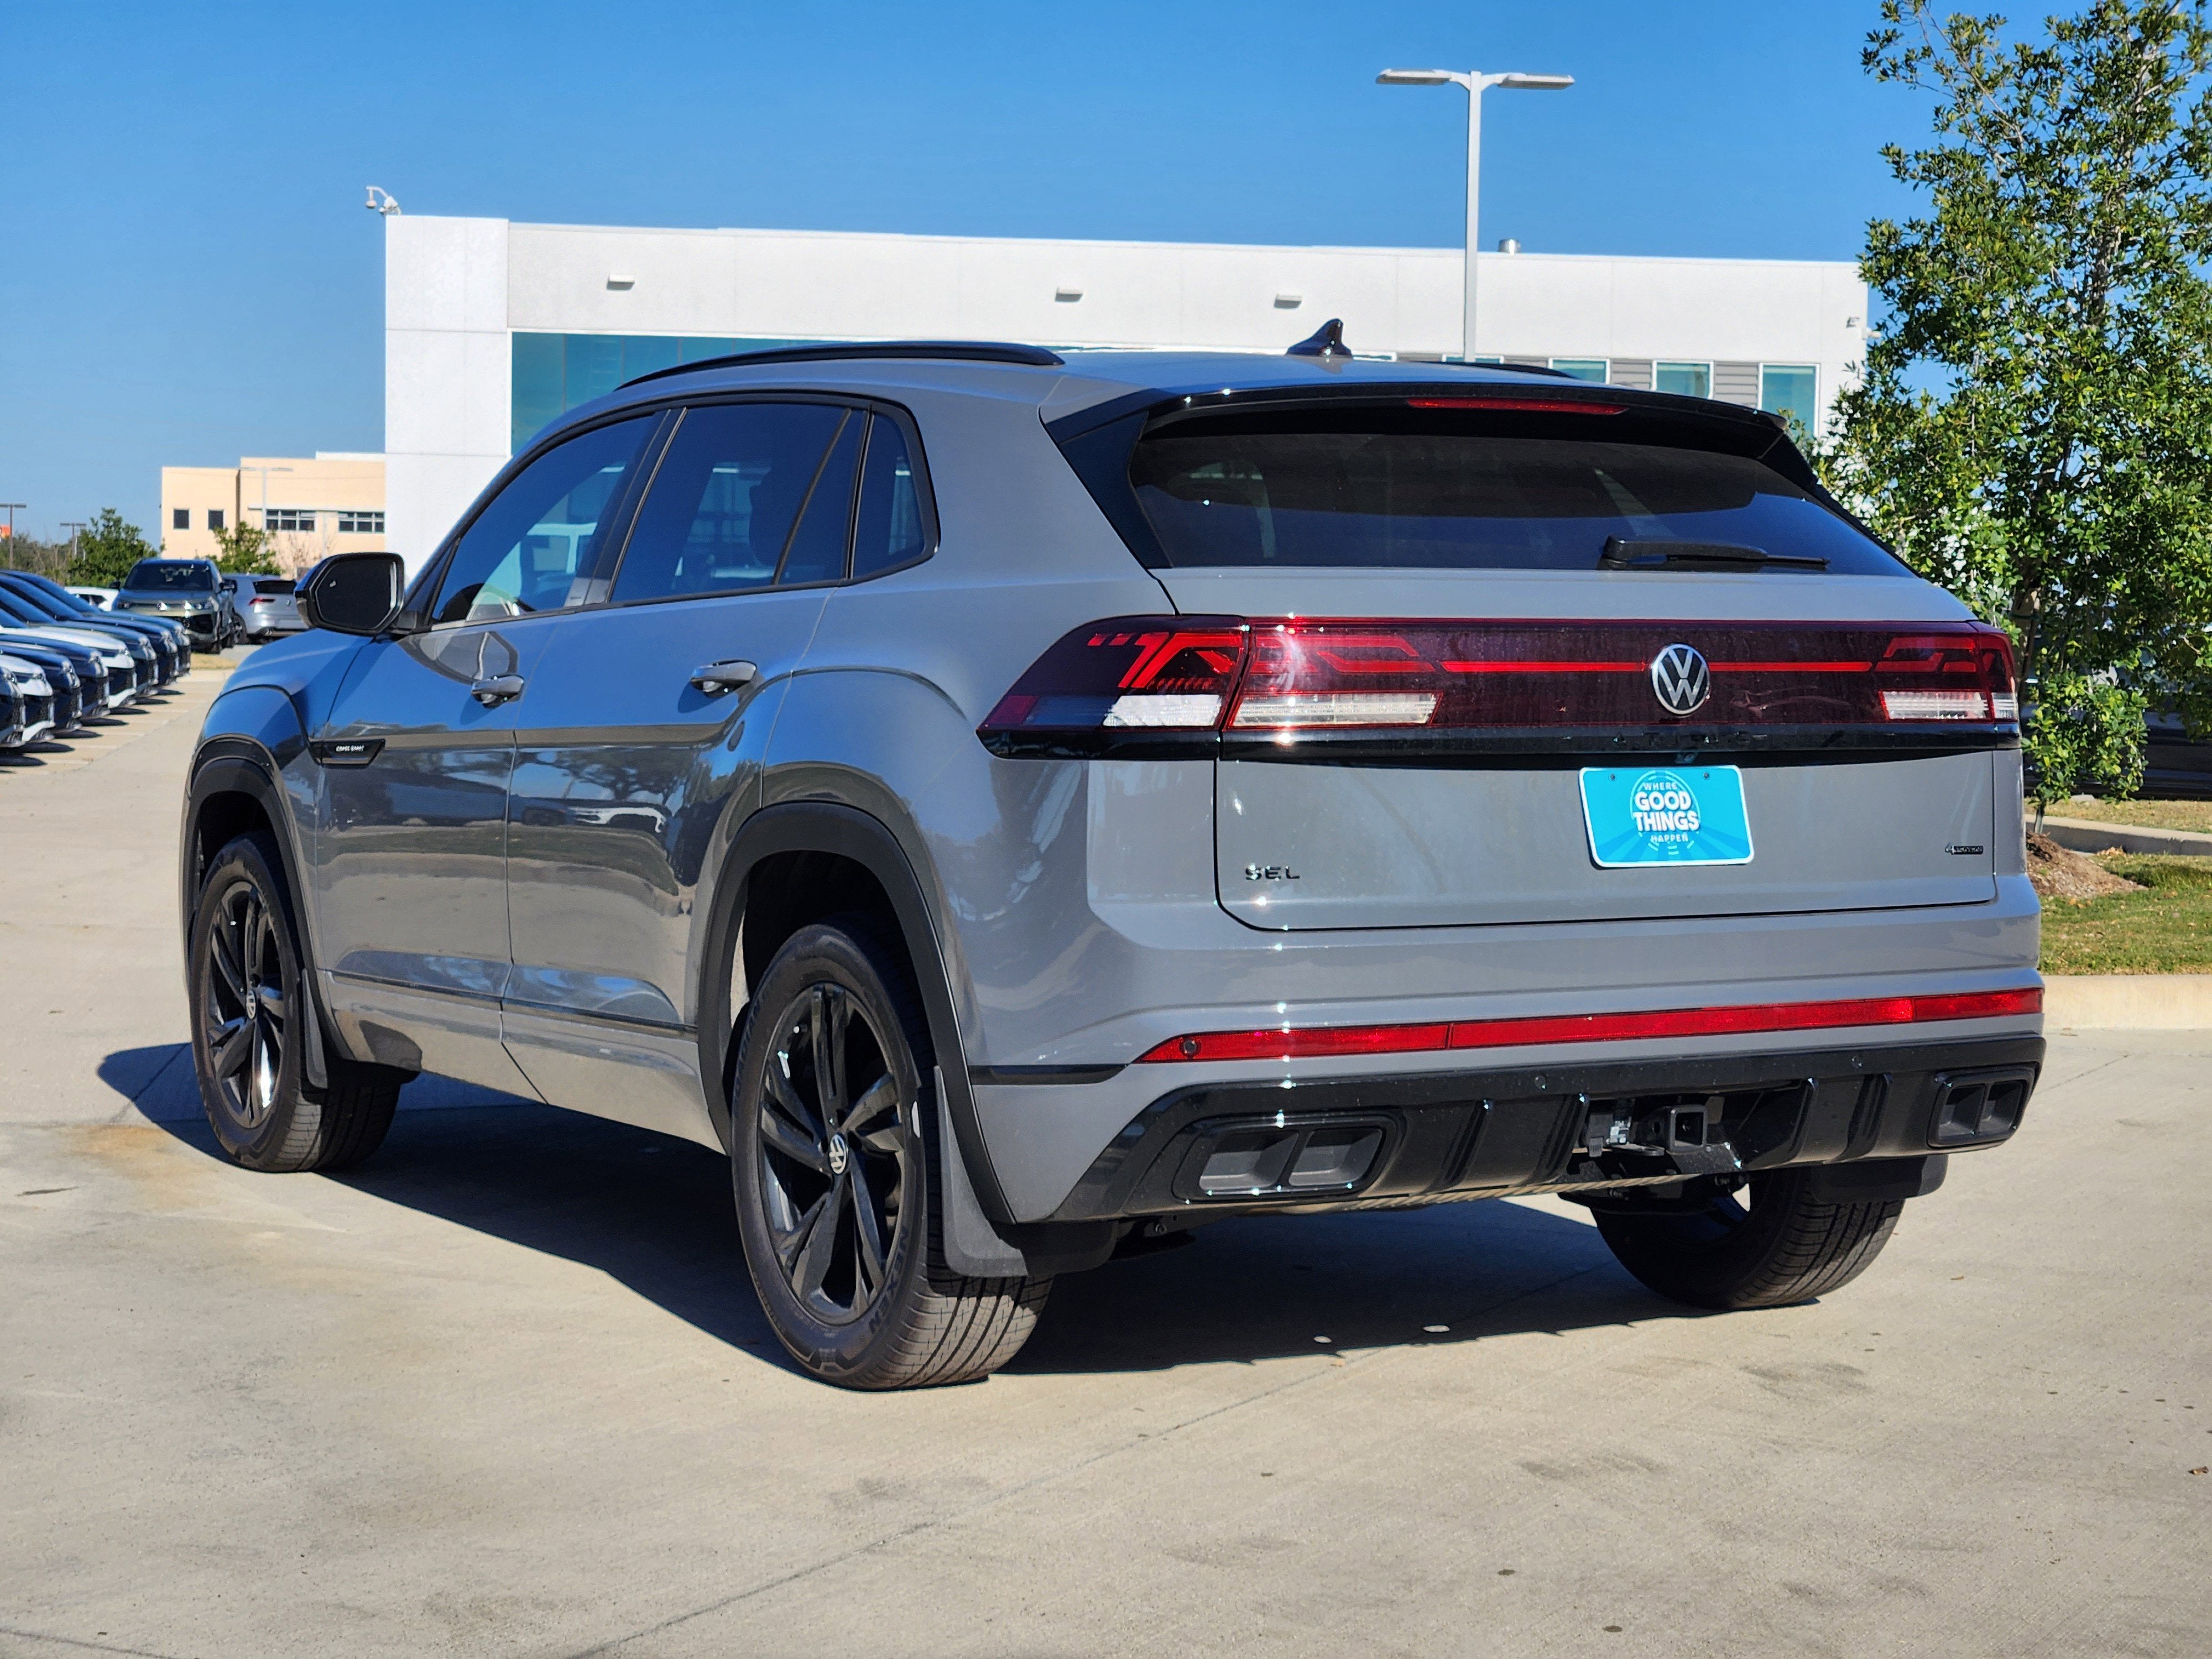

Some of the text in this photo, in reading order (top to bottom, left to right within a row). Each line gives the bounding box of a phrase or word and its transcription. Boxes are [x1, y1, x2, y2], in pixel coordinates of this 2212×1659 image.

[1644, 781, 1677, 791] WHERE
[1635, 791, 1692, 811] GOOD
[1633, 810, 1699, 831] THINGS
[1245, 864, 1300, 880] SEL
[869, 1225, 909, 1334] NEXEN
